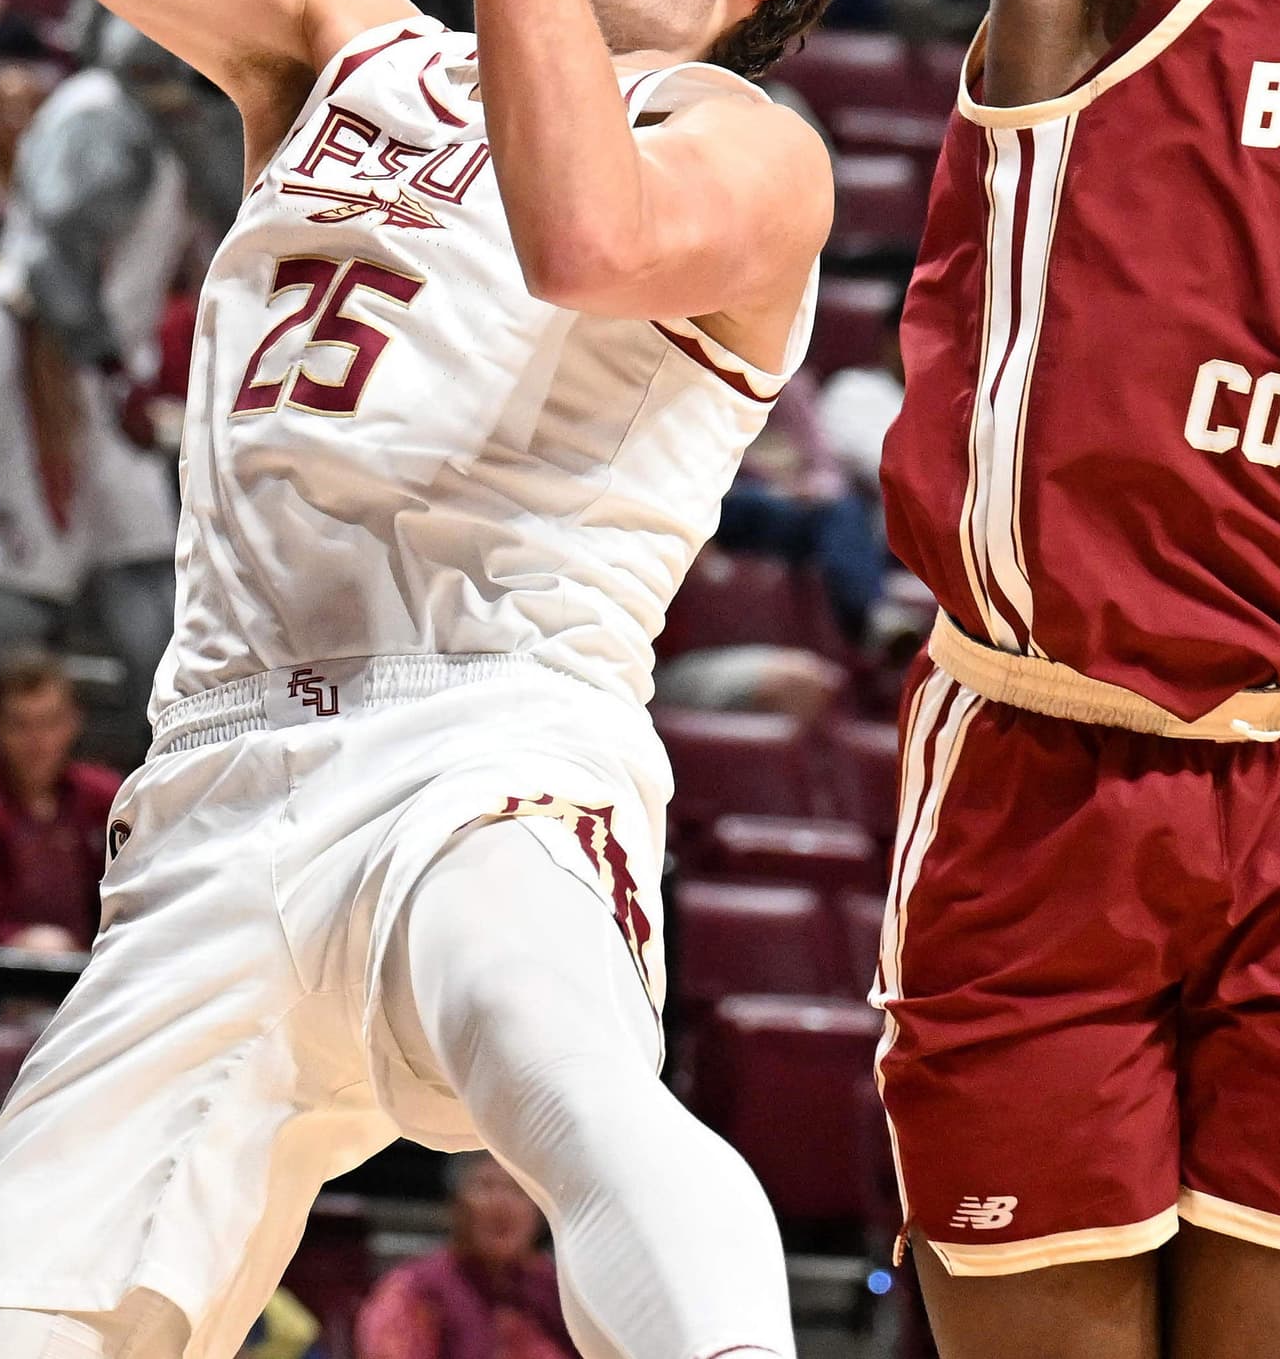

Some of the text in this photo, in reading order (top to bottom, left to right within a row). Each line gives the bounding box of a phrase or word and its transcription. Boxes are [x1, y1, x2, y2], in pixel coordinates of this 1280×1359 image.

[289, 103, 490, 206] FSU
[227, 252, 429, 420] 25
[286, 668, 341, 717] FSU
